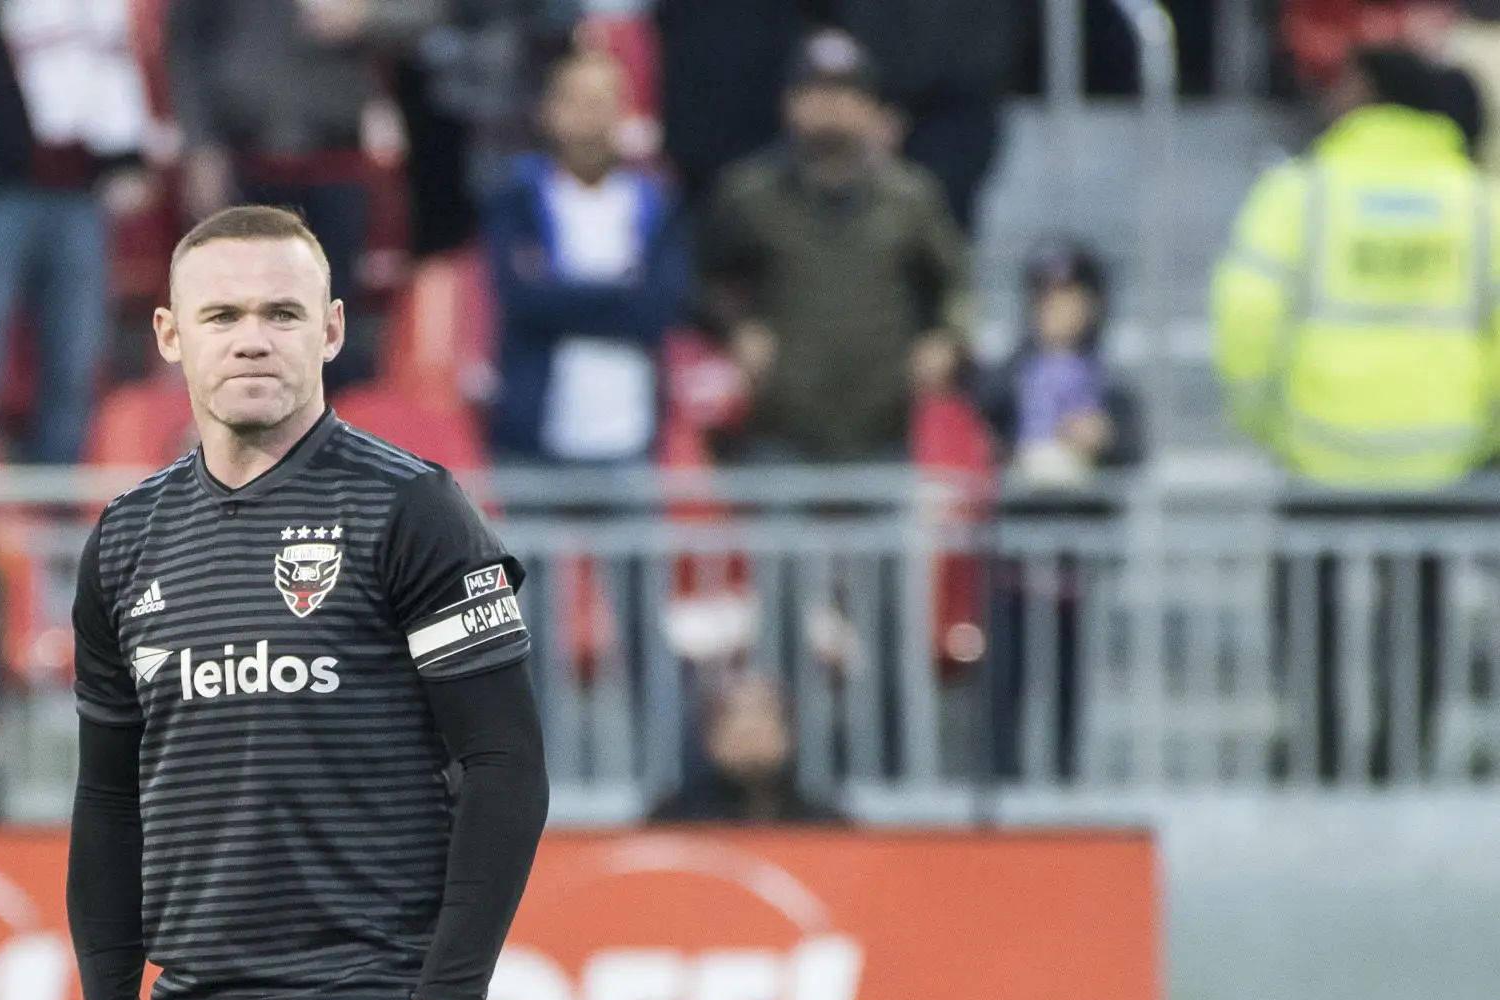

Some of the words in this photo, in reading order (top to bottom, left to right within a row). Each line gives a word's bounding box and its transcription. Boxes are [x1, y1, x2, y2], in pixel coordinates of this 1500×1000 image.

[468, 572, 495, 590] MLS
[131, 600, 165, 617] adidas
[180, 639, 340, 700] leidos
